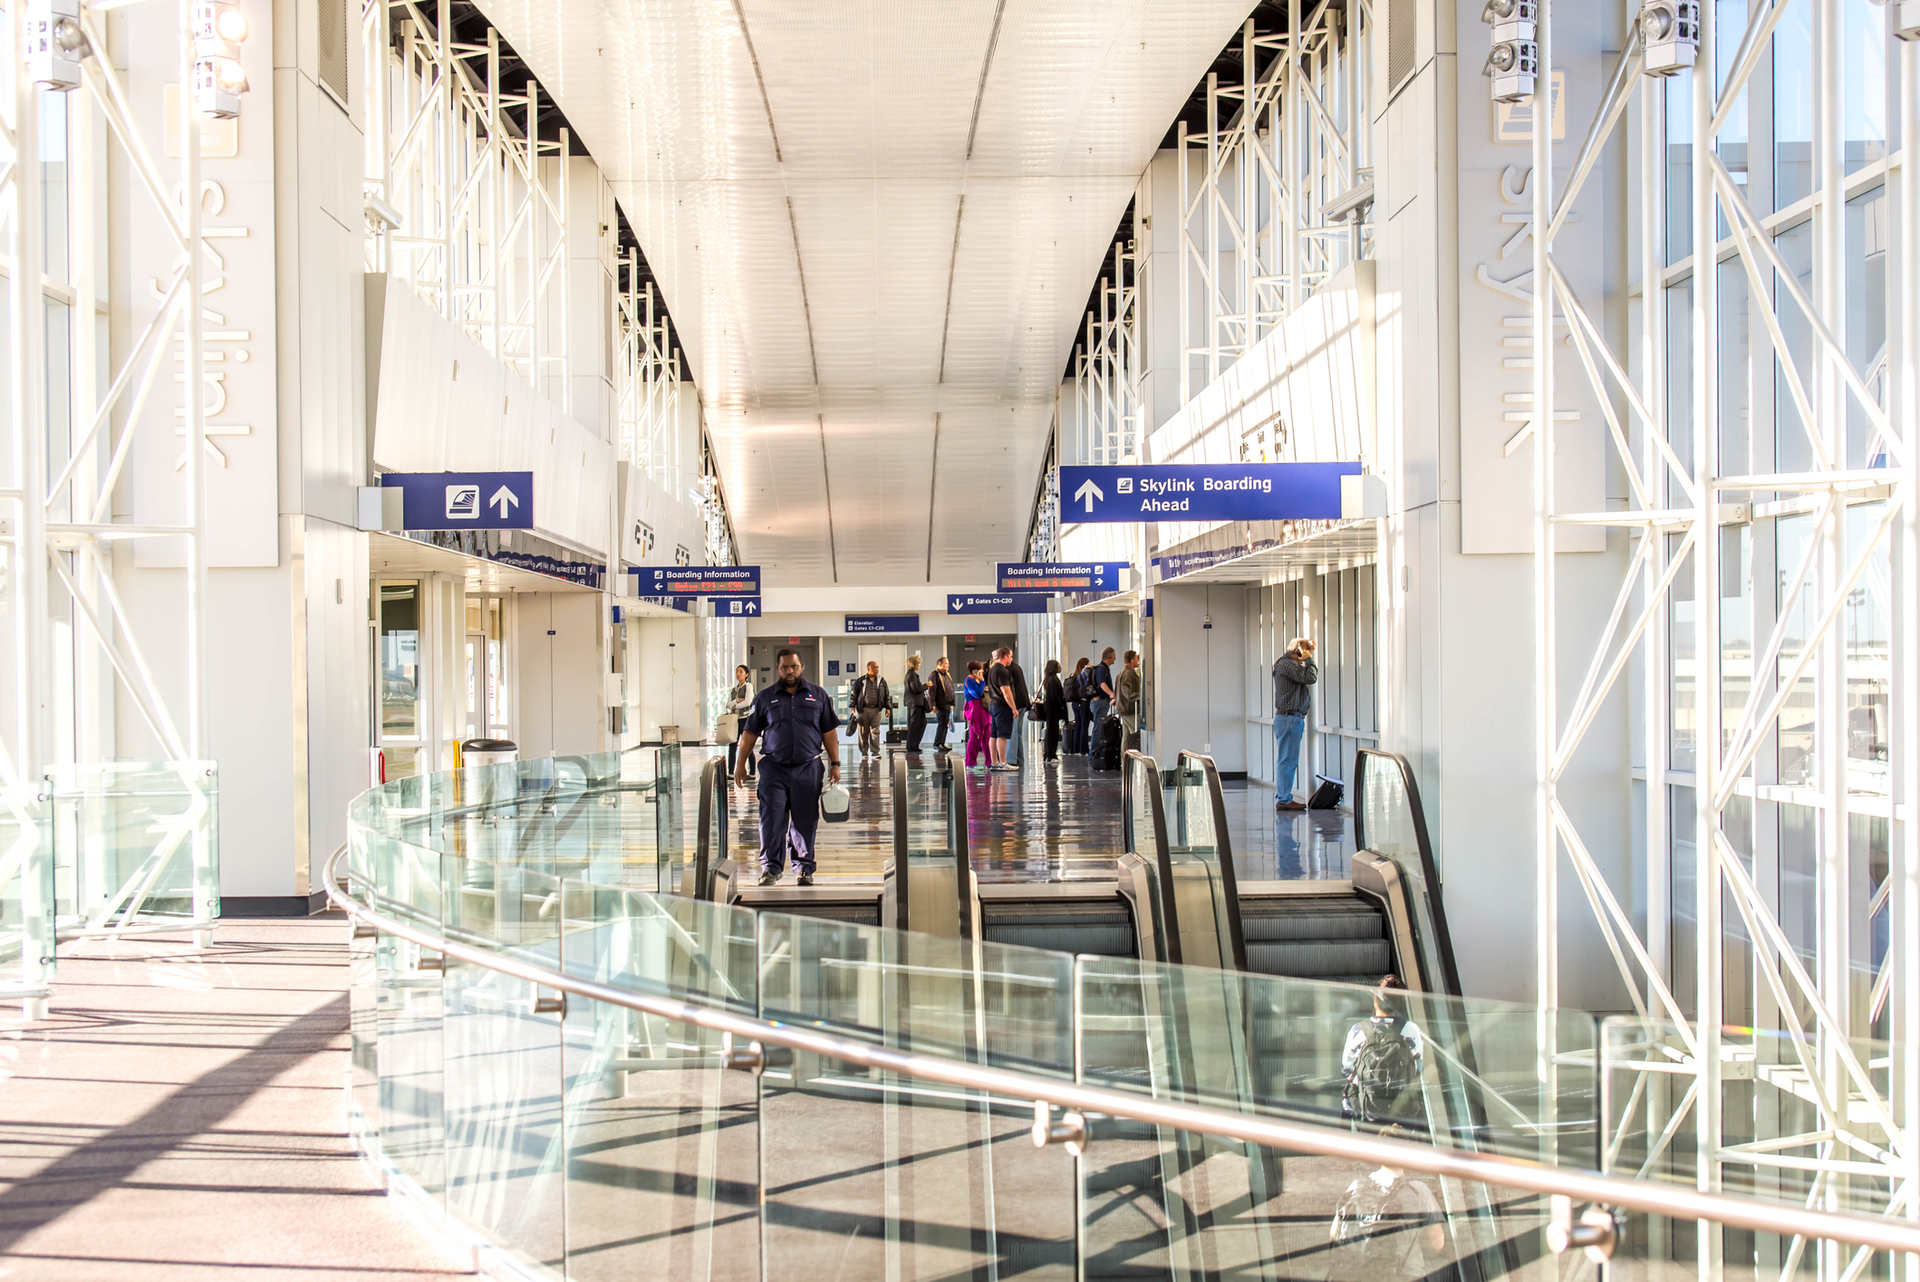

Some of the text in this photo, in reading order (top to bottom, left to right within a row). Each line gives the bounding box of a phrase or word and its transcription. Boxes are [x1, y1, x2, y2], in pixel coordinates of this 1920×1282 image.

[1139, 476, 1273, 496] Skylink Boarding
[1140, 498, 1190, 512] Ahead
[666, 570, 750, 580] Boarding Information
[1007, 566, 1092, 577] Boarding Information
